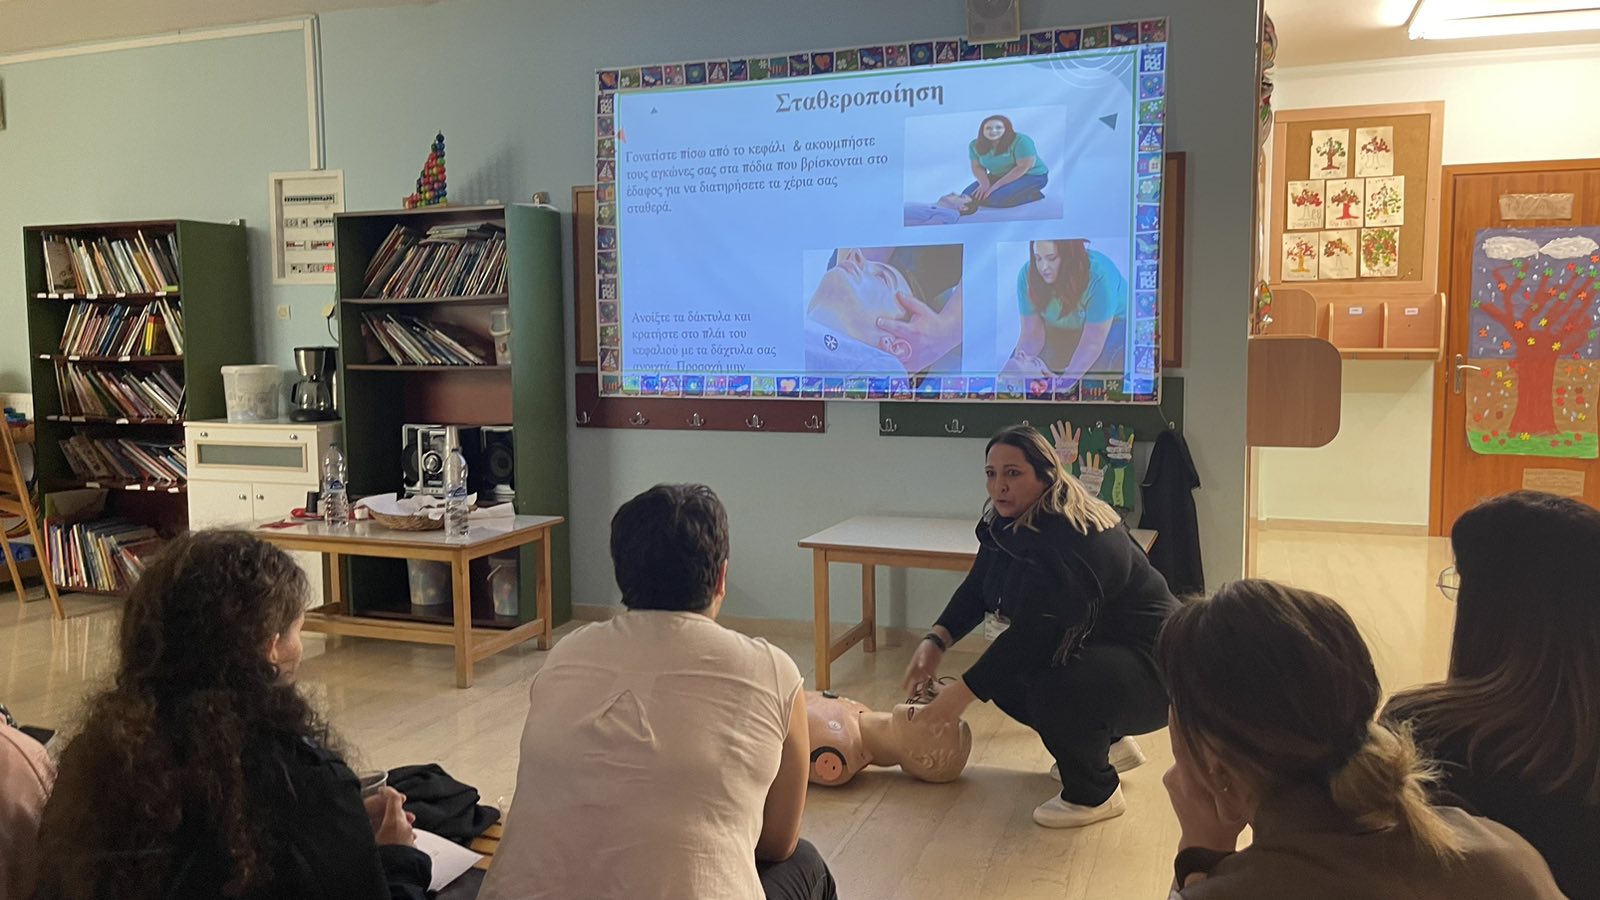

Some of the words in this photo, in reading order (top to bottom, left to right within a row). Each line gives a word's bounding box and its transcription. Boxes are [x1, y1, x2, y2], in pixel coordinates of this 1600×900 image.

[776, 82, 944, 113] Σταθεροποίηση
[626, 147, 678, 163] Γονατίστε
[680, 146, 706, 160] πίσω
[709, 145, 729, 157] από
[733, 146, 745, 156] το
[748, 140, 785, 157] κεφάλι
[793, 139, 802, 152] &
[805, 135, 876, 152] ακουμπήστε
[627, 169, 648, 180] τους
[651, 166, 695, 181] αγκώνες
[697, 165, 717, 178] σας
[719, 164, 739, 175] στα
[742, 159, 773, 173] πόδια
[777, 160, 798, 171] που
[801, 155, 863, 172] βρίσκονται
[867, 154, 888, 165] στο
[626, 184, 662, 198] έδαφος
[665, 185, 681, 197] για
[684, 184, 697, 194] να
[699, 180, 766, 194] διατηρήσετε
[768, 180, 781, 190] τα
[784, 176, 814, 191] χέρια
[817, 176, 838, 188] σας
[627, 201, 672, 215] σταθερά.
[631, 311, 671, 324] Ανοίξτε
[673, 313, 685, 323] τα
[687, 310, 731, 323] δάκτυλα
[734, 312, 752, 322] και
[631, 329, 679, 341] κρατήστε
[681, 330, 699, 339] στο
[702, 327, 726, 339] πλάι
[729, 330, 747, 339] του
[632, 344, 678, 358] κεφαλιού
[681, 346, 694, 357] με
[696, 346, 708, 355] τα
[710, 343, 754, 357] δάχτυλα
[757, 345, 777, 357] σας
